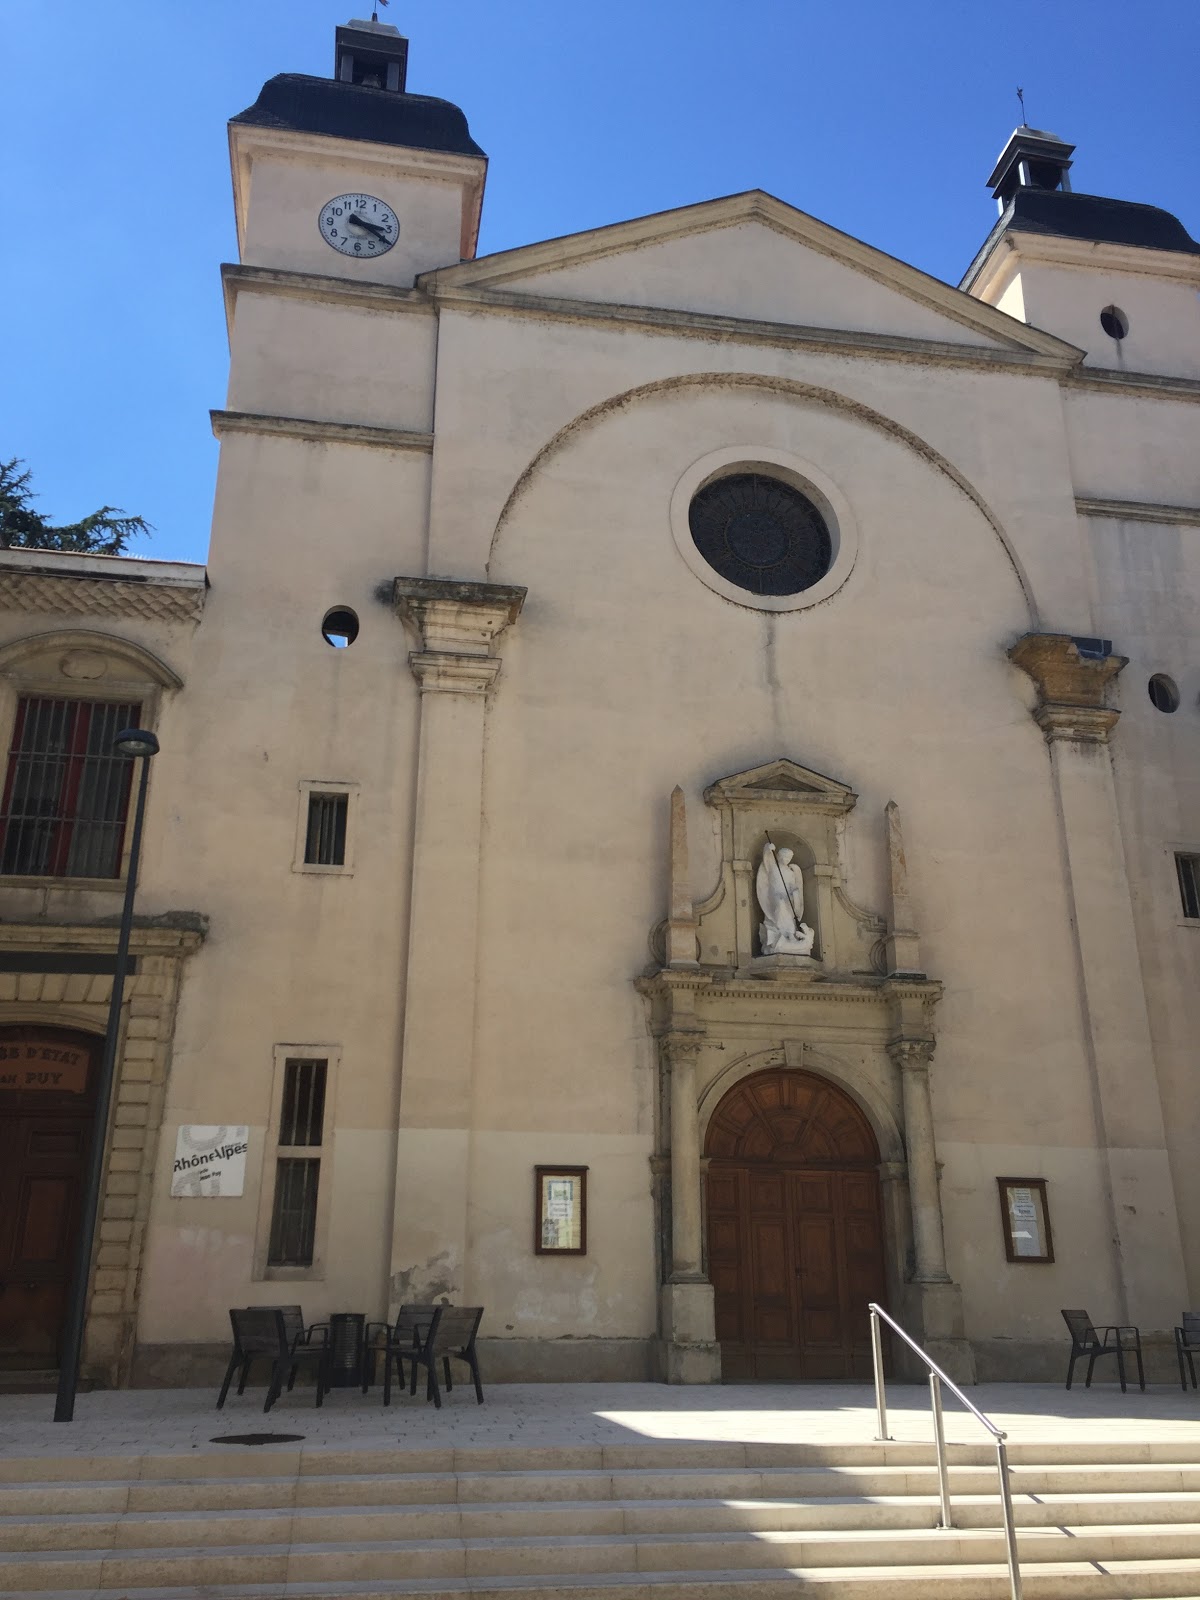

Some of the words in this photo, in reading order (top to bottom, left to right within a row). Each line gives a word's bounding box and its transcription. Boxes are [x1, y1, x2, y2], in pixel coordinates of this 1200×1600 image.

[344, 201, 352, 210] 11
[355, 199, 367, 208] 12
[373, 204, 377, 212] 1
[332, 207, 343, 216] 10
[326, 217, 334, 226] 9
[381, 214, 389, 222] 2
[330, 229, 338, 237] 8
[385, 225, 392, 233] 3
[340, 237, 348, 246] 7
[368, 241, 375, 249] 5
[354, 242, 361, 252] 6
[25, 1072, 63, 1084] PUY
